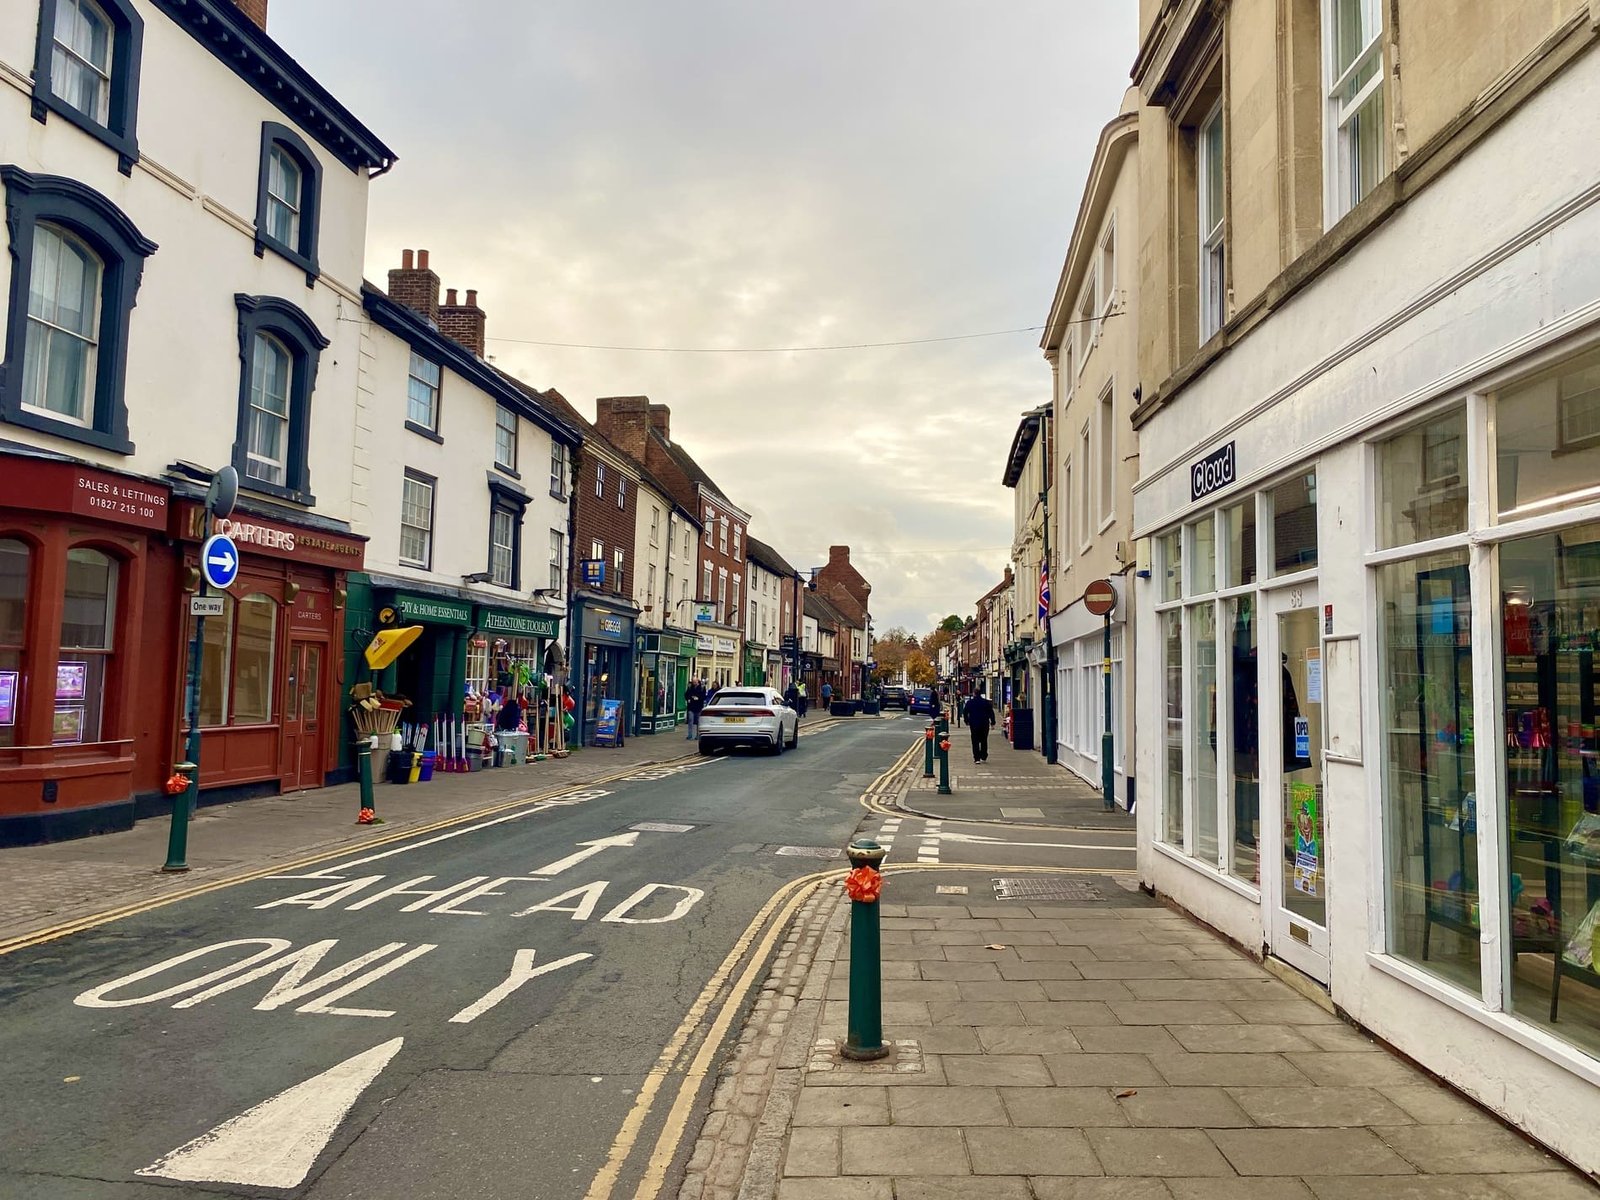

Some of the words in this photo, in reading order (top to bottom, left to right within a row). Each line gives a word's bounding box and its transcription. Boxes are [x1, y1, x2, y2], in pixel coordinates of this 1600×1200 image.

[1193, 444, 1233, 497] Cloud
[79, 478, 110, 494] SALES
[112, 486, 119, 496] &
[122, 488, 165, 506] LETTINGS
[90, 496, 117, 510] 01827
[120, 503, 136, 514] 215
[139, 507, 154, 518] 100
[219, 518, 295, 551] CARTERS
[300, 536, 331, 550] ESTATE
[193, 602, 207, 611] One
[208, 604, 222, 613] way
[297, 611, 322, 621] CARTERS
[401, 601, 413, 614] DIY
[413, 604, 419, 614] &
[419, 604, 438, 617] HOME
[438, 607, 468, 621] ESSENTIALS
[484, 611, 526, 630] ATHERSTONE
[527, 619, 554, 635] TOOLBOX
[604, 619, 621, 633] GREGGS
[254, 874, 704, 924] AHEAD
[73, 938, 594, 1024] ONLY
